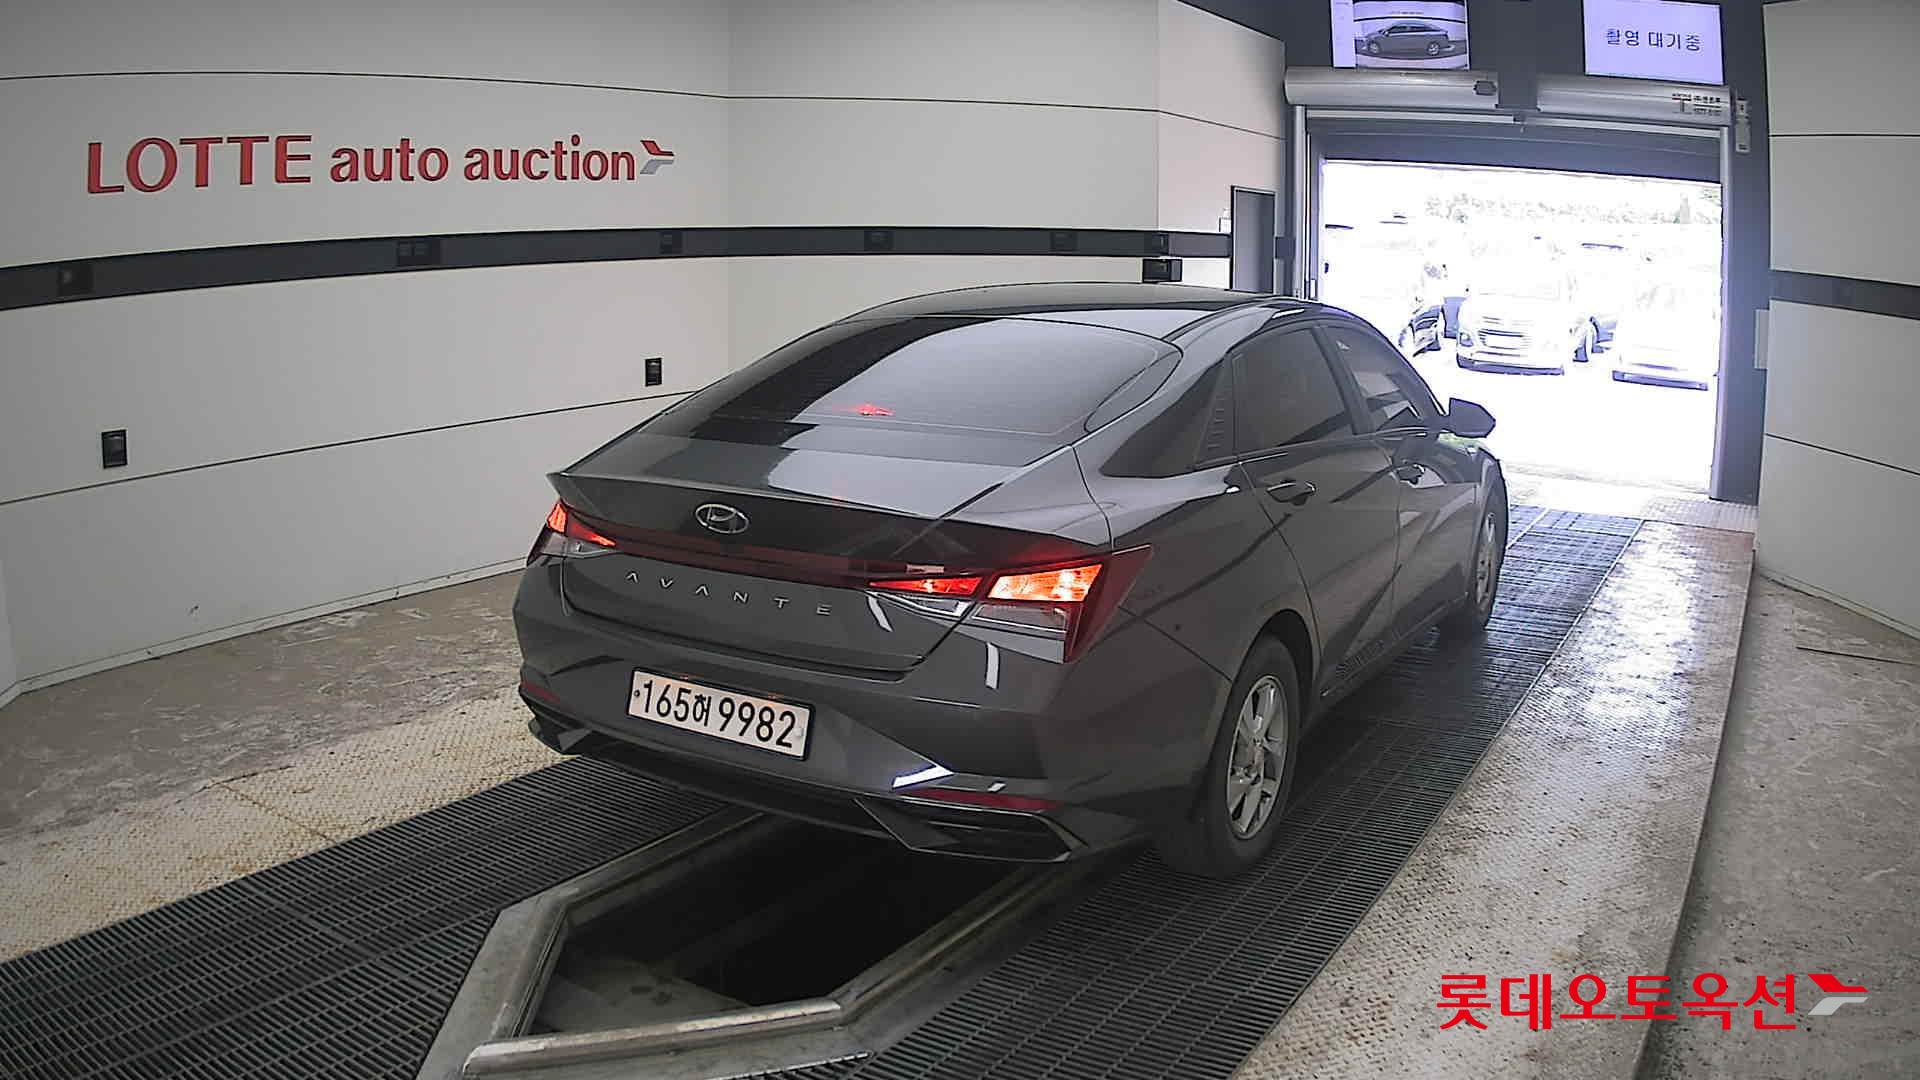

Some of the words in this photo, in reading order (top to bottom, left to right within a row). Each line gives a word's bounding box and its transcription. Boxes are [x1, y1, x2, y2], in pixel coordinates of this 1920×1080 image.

[1606, 28, 1640, 47] 촬영
[87, 135, 312, 193] LOTTE
[329, 138, 449, 182] auto
[463, 134, 636, 181] auction
[626, 571, 832, 615] AVANTE
